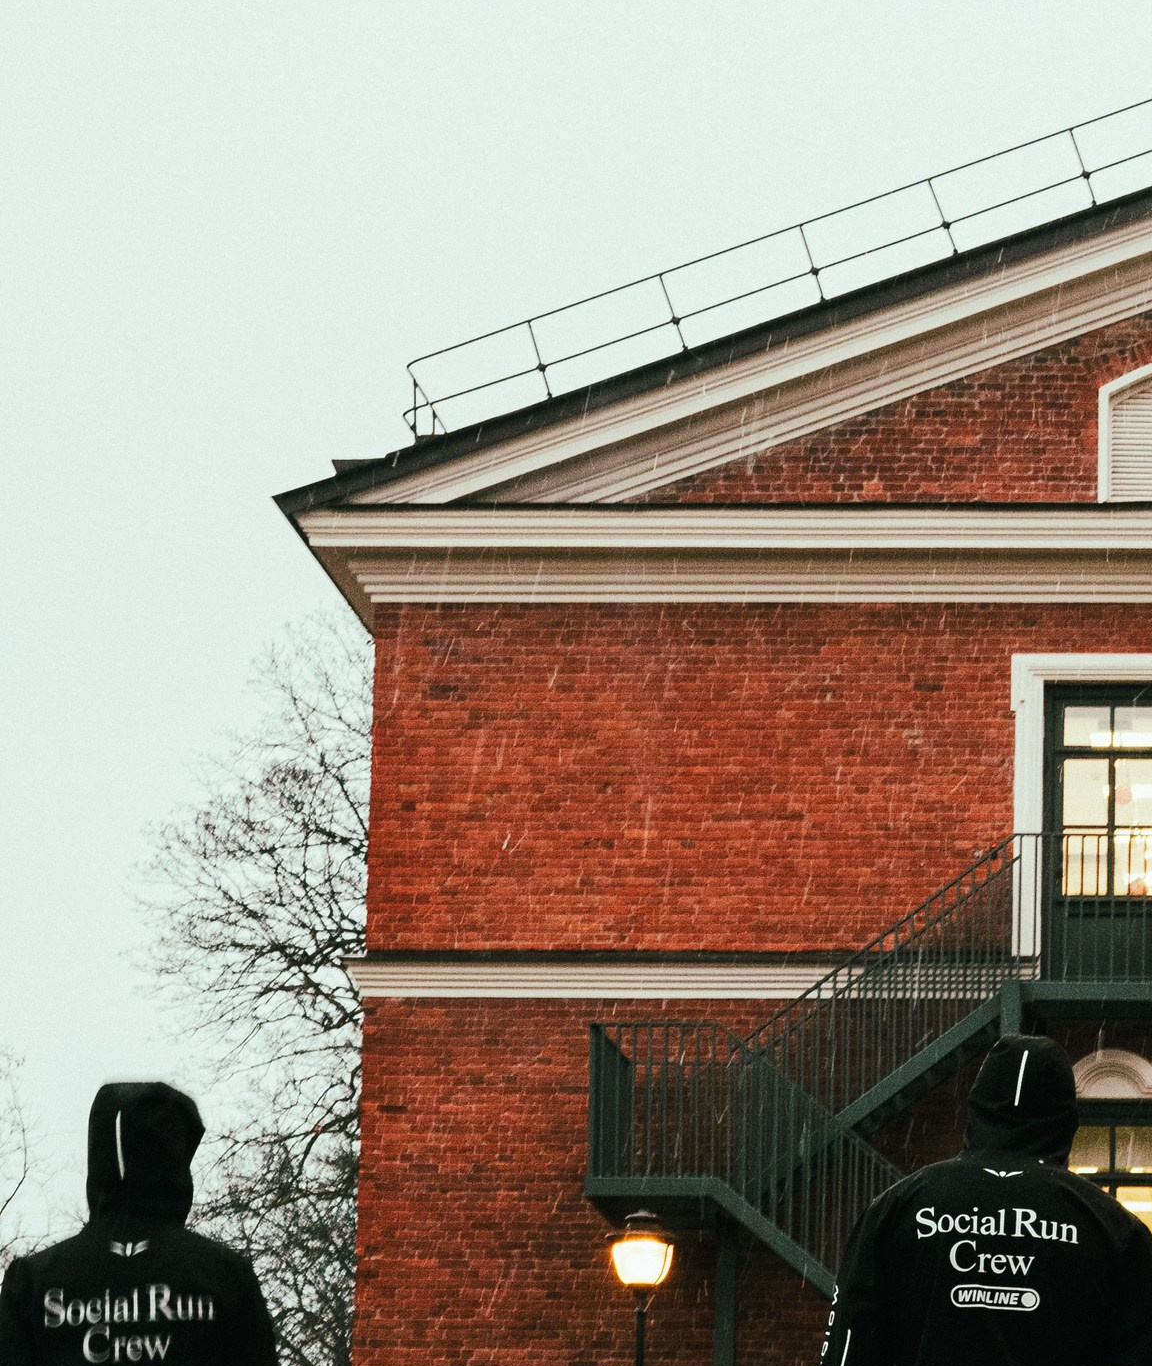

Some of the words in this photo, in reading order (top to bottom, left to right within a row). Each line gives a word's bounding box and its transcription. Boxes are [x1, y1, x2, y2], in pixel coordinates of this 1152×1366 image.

[915, 1206, 1007, 1239] Social
[1011, 1207, 1079, 1244] Run
[949, 1239, 1035, 1276] Crew
[44, 1286, 140, 1328] Social
[148, 1284, 215, 1322] Run
[957, 1289, 1020, 1306] WINLINE
[82, 1324, 171, 1363] Crew
